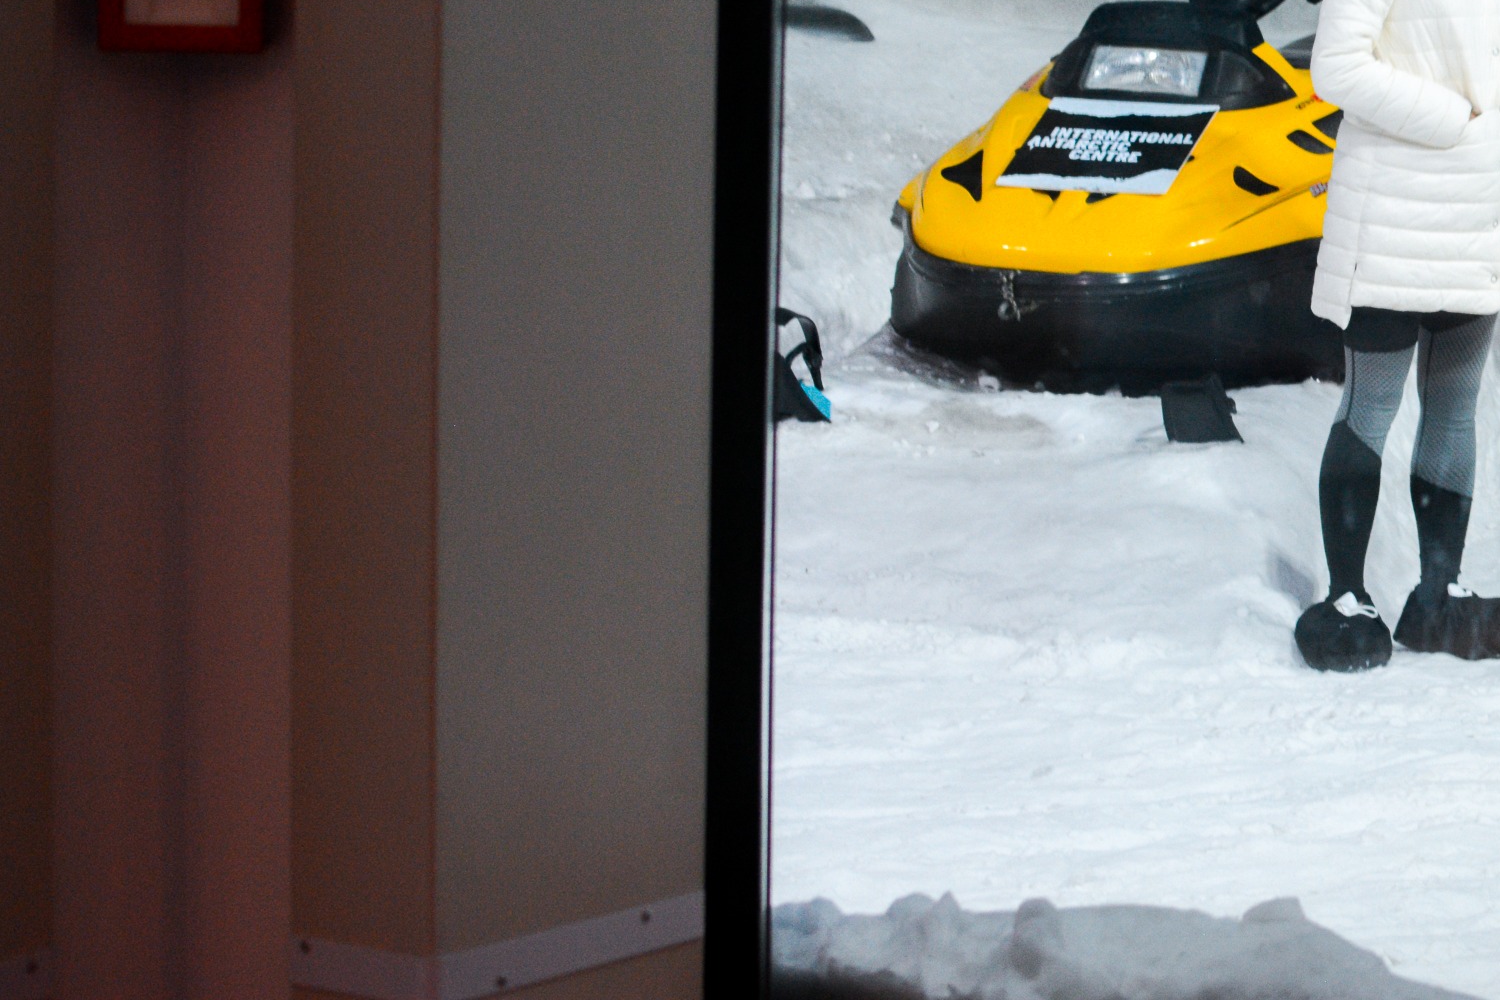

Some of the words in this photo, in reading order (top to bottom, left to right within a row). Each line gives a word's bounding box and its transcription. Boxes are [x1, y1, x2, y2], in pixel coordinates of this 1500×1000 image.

[1027, 135, 1131, 152] ANTARCTIC
[1050, 127, 1193, 144] INTERNATIONAL
[1069, 150, 1142, 163] CENTRE
